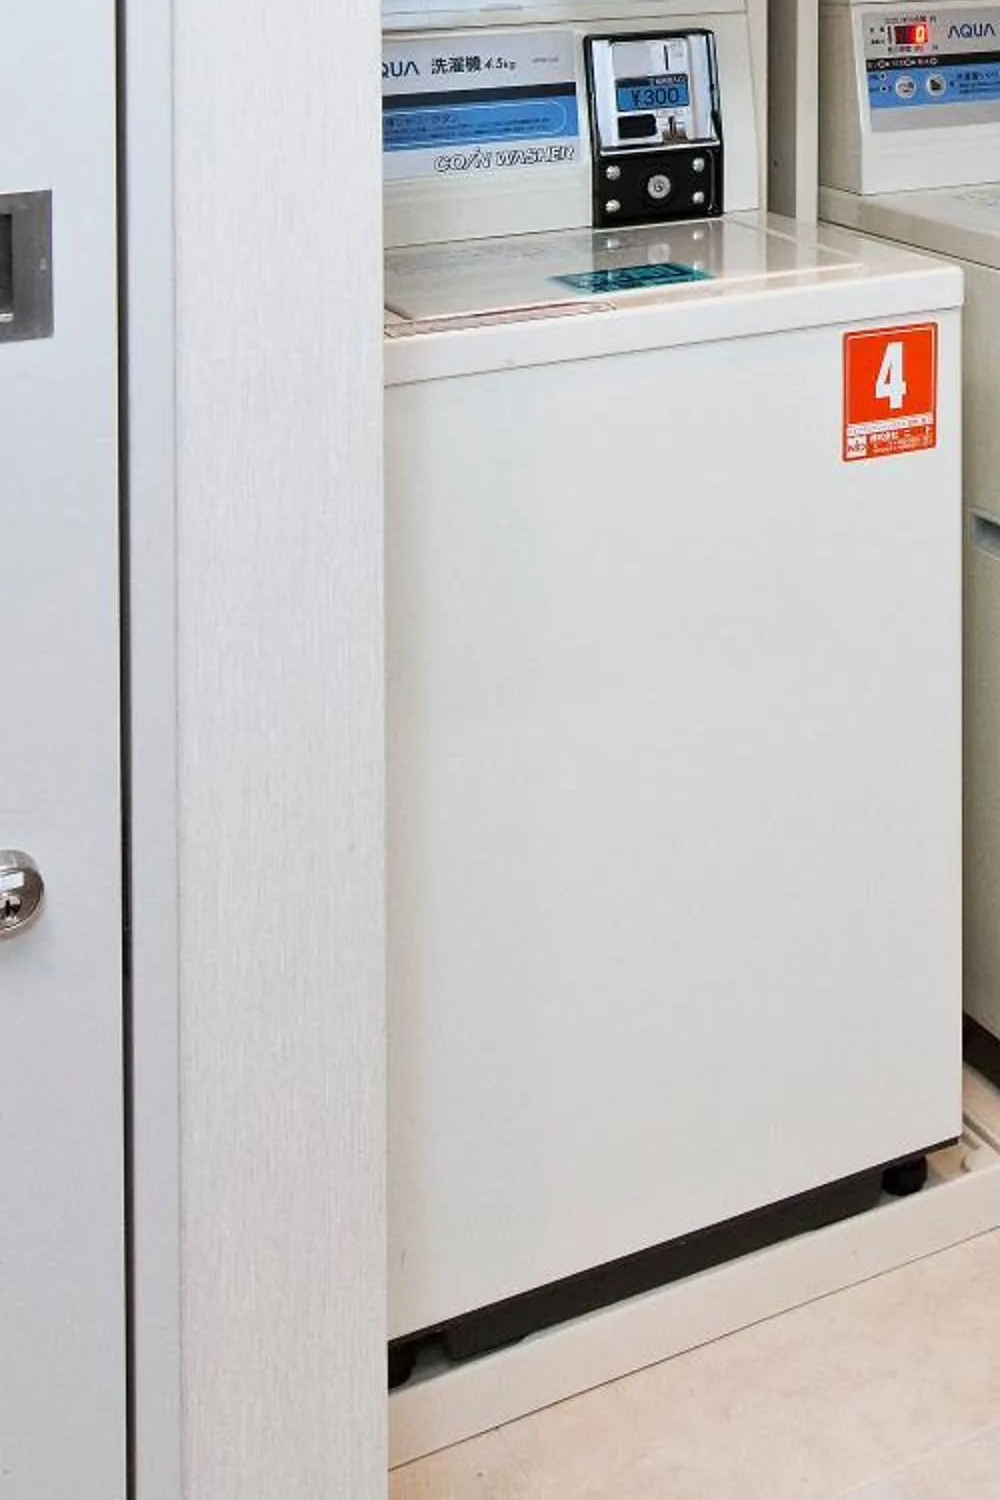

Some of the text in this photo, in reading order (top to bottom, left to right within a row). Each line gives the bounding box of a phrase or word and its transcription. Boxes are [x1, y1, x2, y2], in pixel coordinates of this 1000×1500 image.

[947, 22, 997, 39] AQUA
[381, 60, 420, 78] QUA
[430, 55, 481, 75] 洗濯機
[631, 86, 680, 106] ¥300
[495, 144, 576, 167] WASHER
[874, 340, 907, 410] 4
